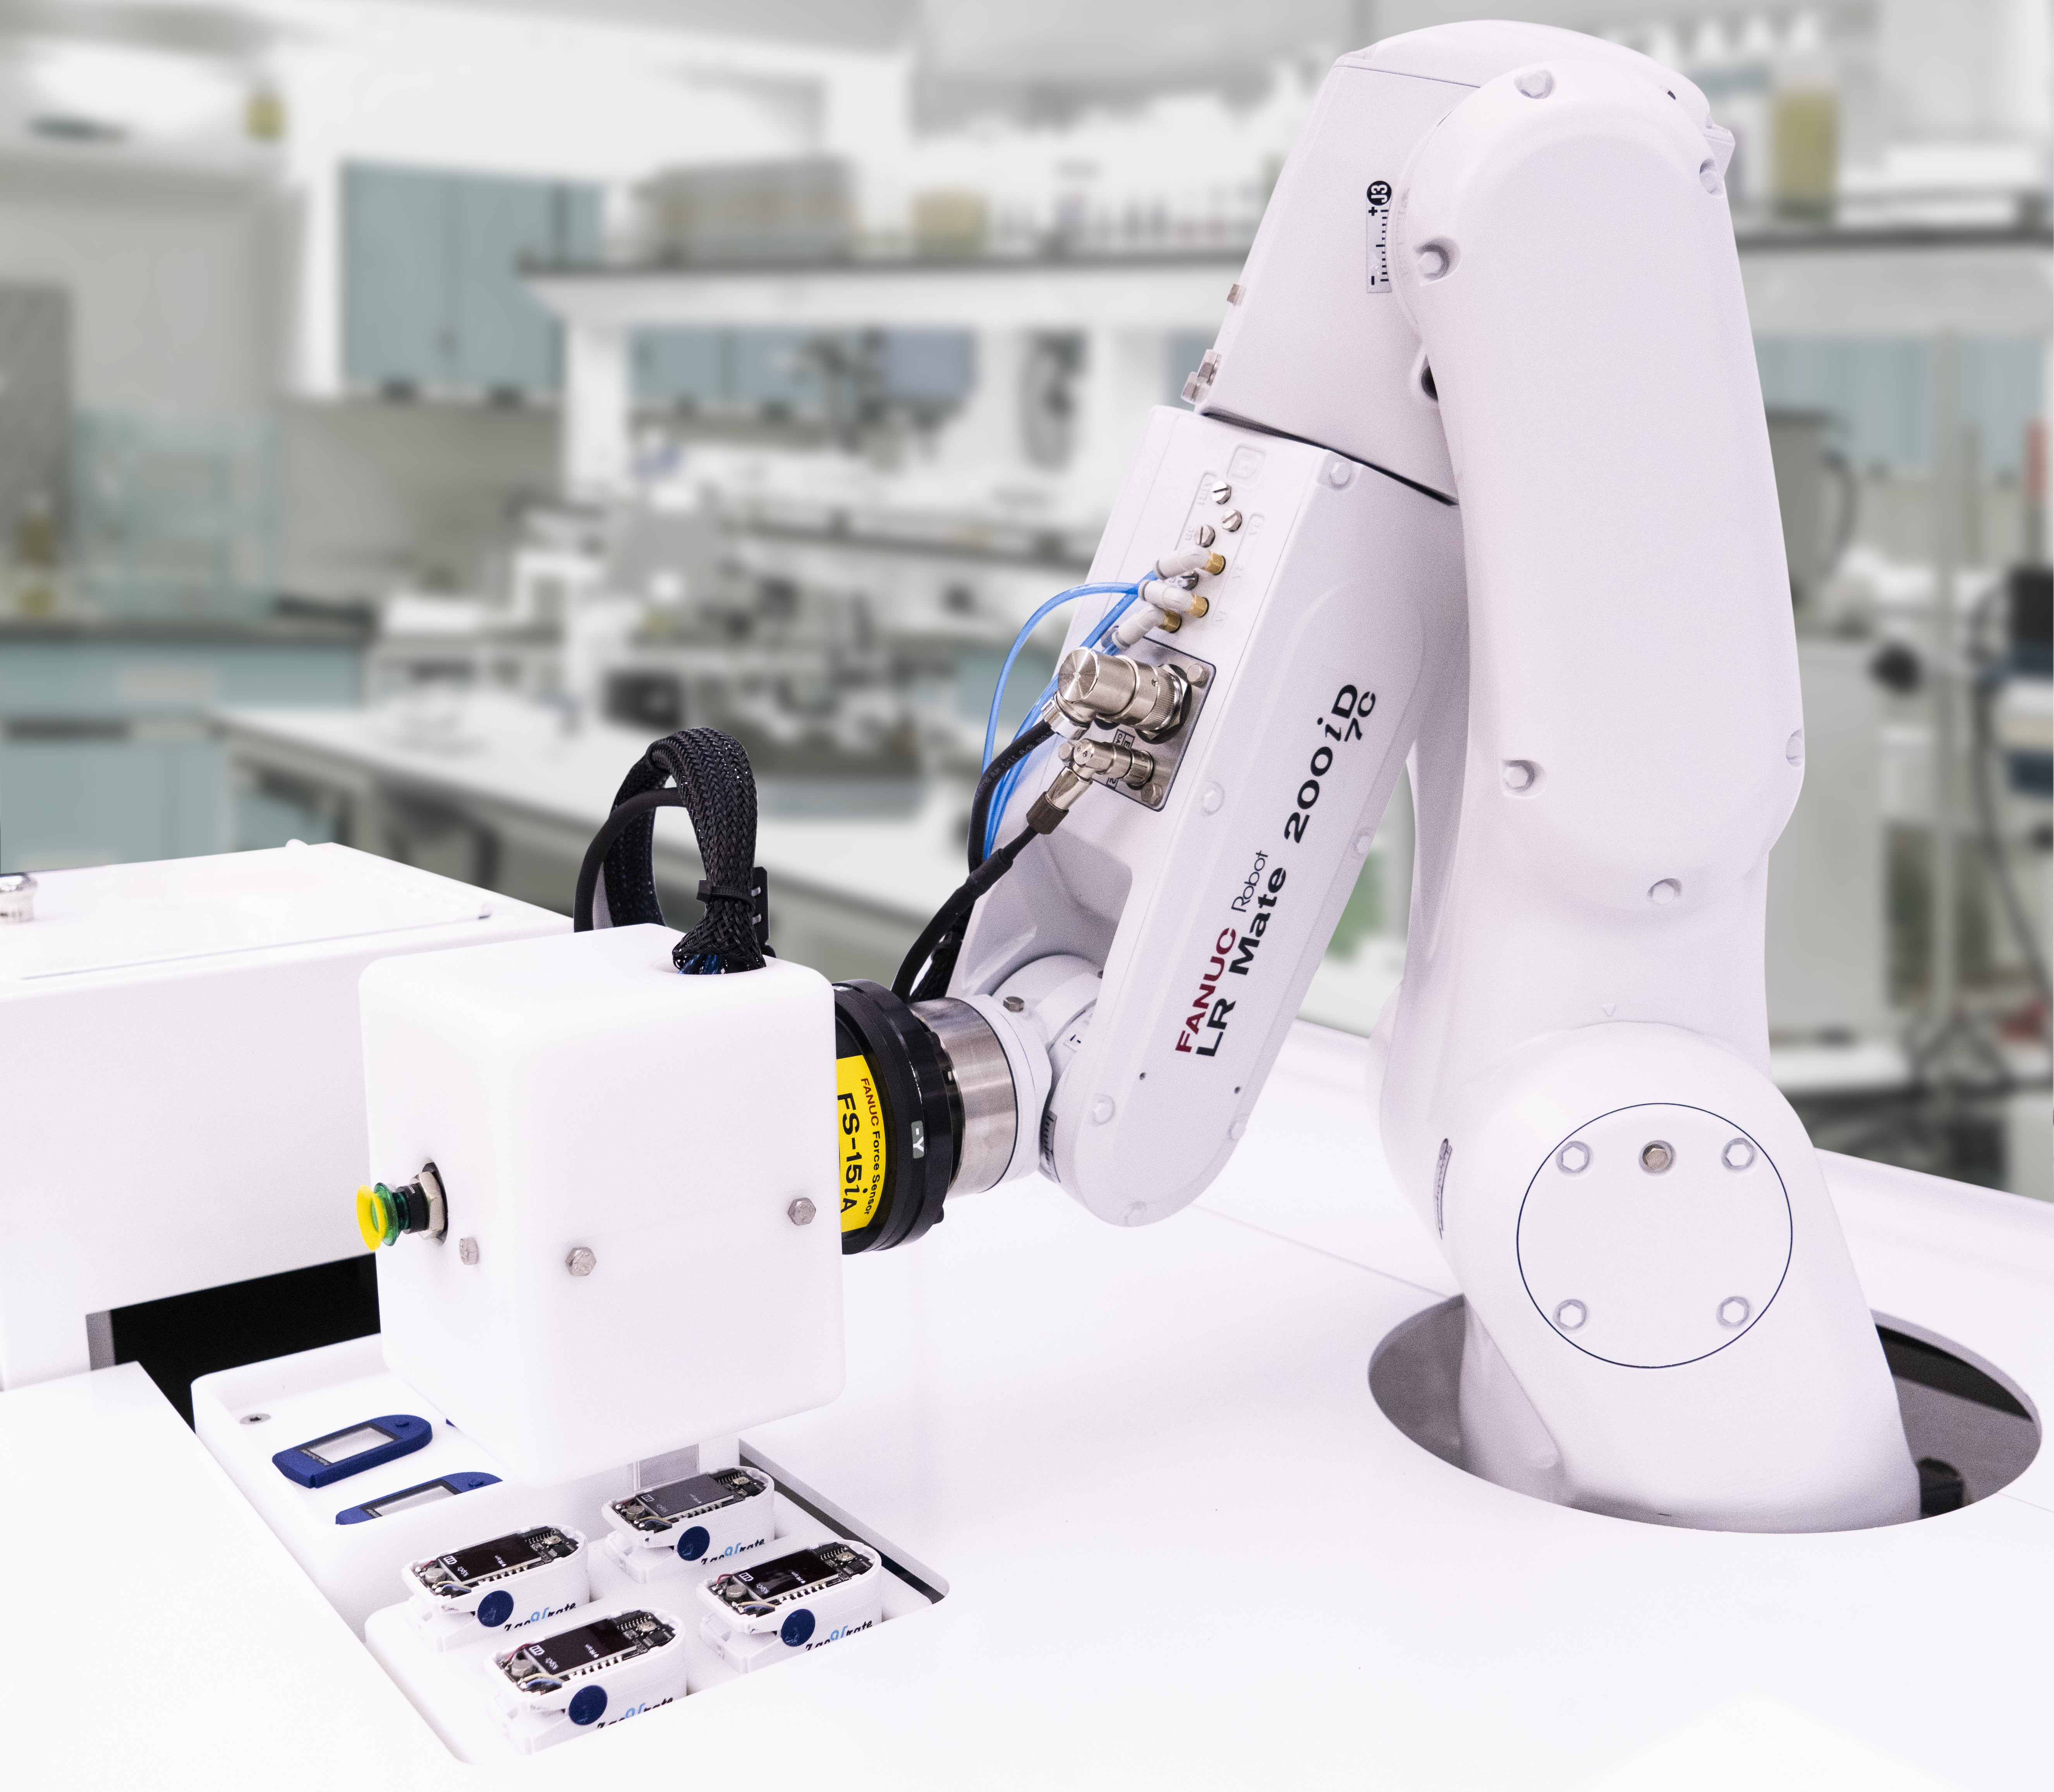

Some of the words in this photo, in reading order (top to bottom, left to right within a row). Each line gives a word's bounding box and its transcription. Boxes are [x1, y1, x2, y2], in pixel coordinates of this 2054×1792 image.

[1371, 185, 1388, 203] J3
[1175, 928, 1236, 1053] FANUC
[1231, 851, 1268, 913] Robot
[1195, 998, 1236, 1057] LR
[1228, 867, 1286, 975] Mate
[861, 1078, 879, 1126] FANUC
[838, 1092, 868, 1213] FS-15iA
[864, 1174, 880, 1215] Sensor
